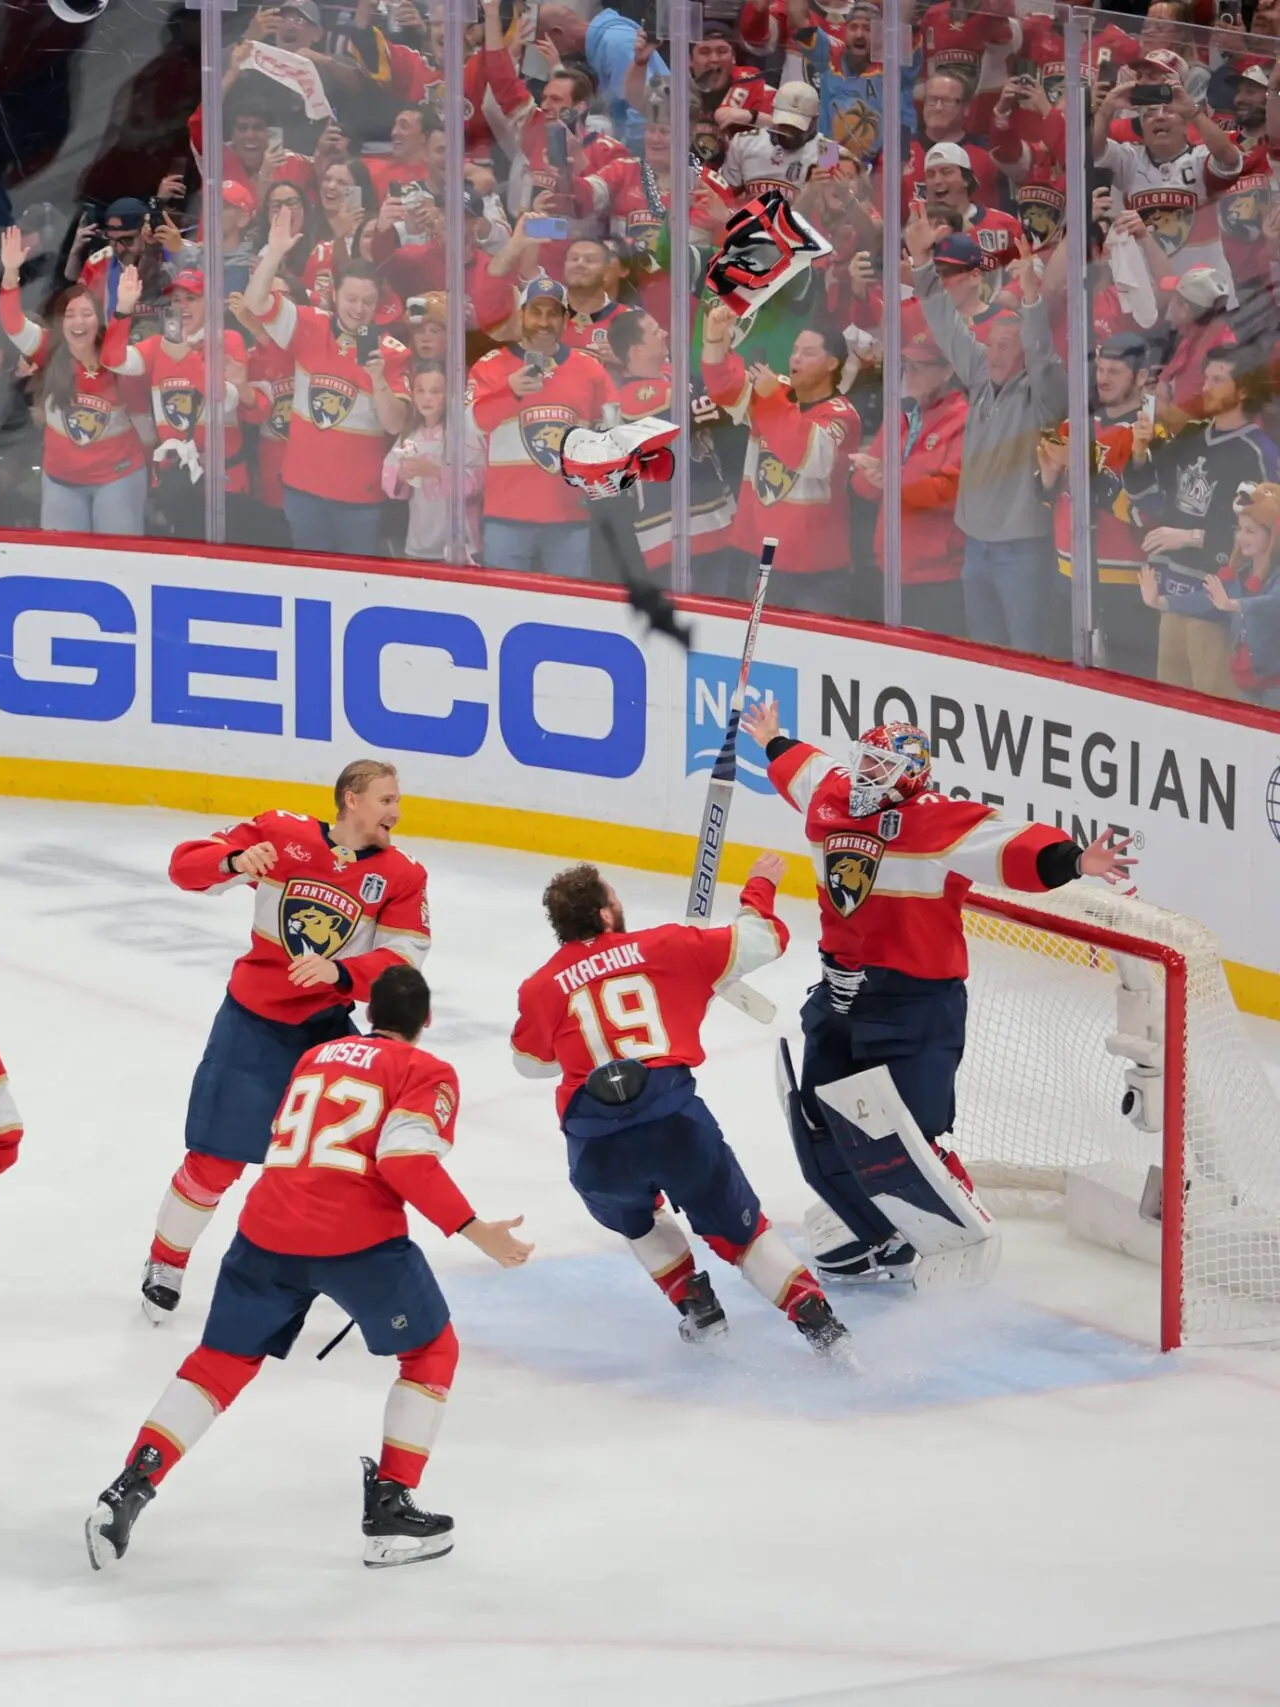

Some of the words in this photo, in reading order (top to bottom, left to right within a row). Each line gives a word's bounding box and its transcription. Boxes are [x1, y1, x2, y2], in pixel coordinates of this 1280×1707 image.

[1181, 166, 1195, 185] C
[1137, 192, 1191, 206] FLORIDA
[314, 377, 357, 397] PANTHERS
[821, 674, 1236, 831] NORWEGIAN
[694, 802, 723, 918] BAUER
[828, 836, 879, 855] PANTHERS
[293, 884, 355, 916] PANTHERS
[554, 942, 645, 995] TKACHUK
[567, 973, 671, 1068] 19
[314, 1041, 383, 1070] NOSEK
[264, 1073, 384, 1175] 92
